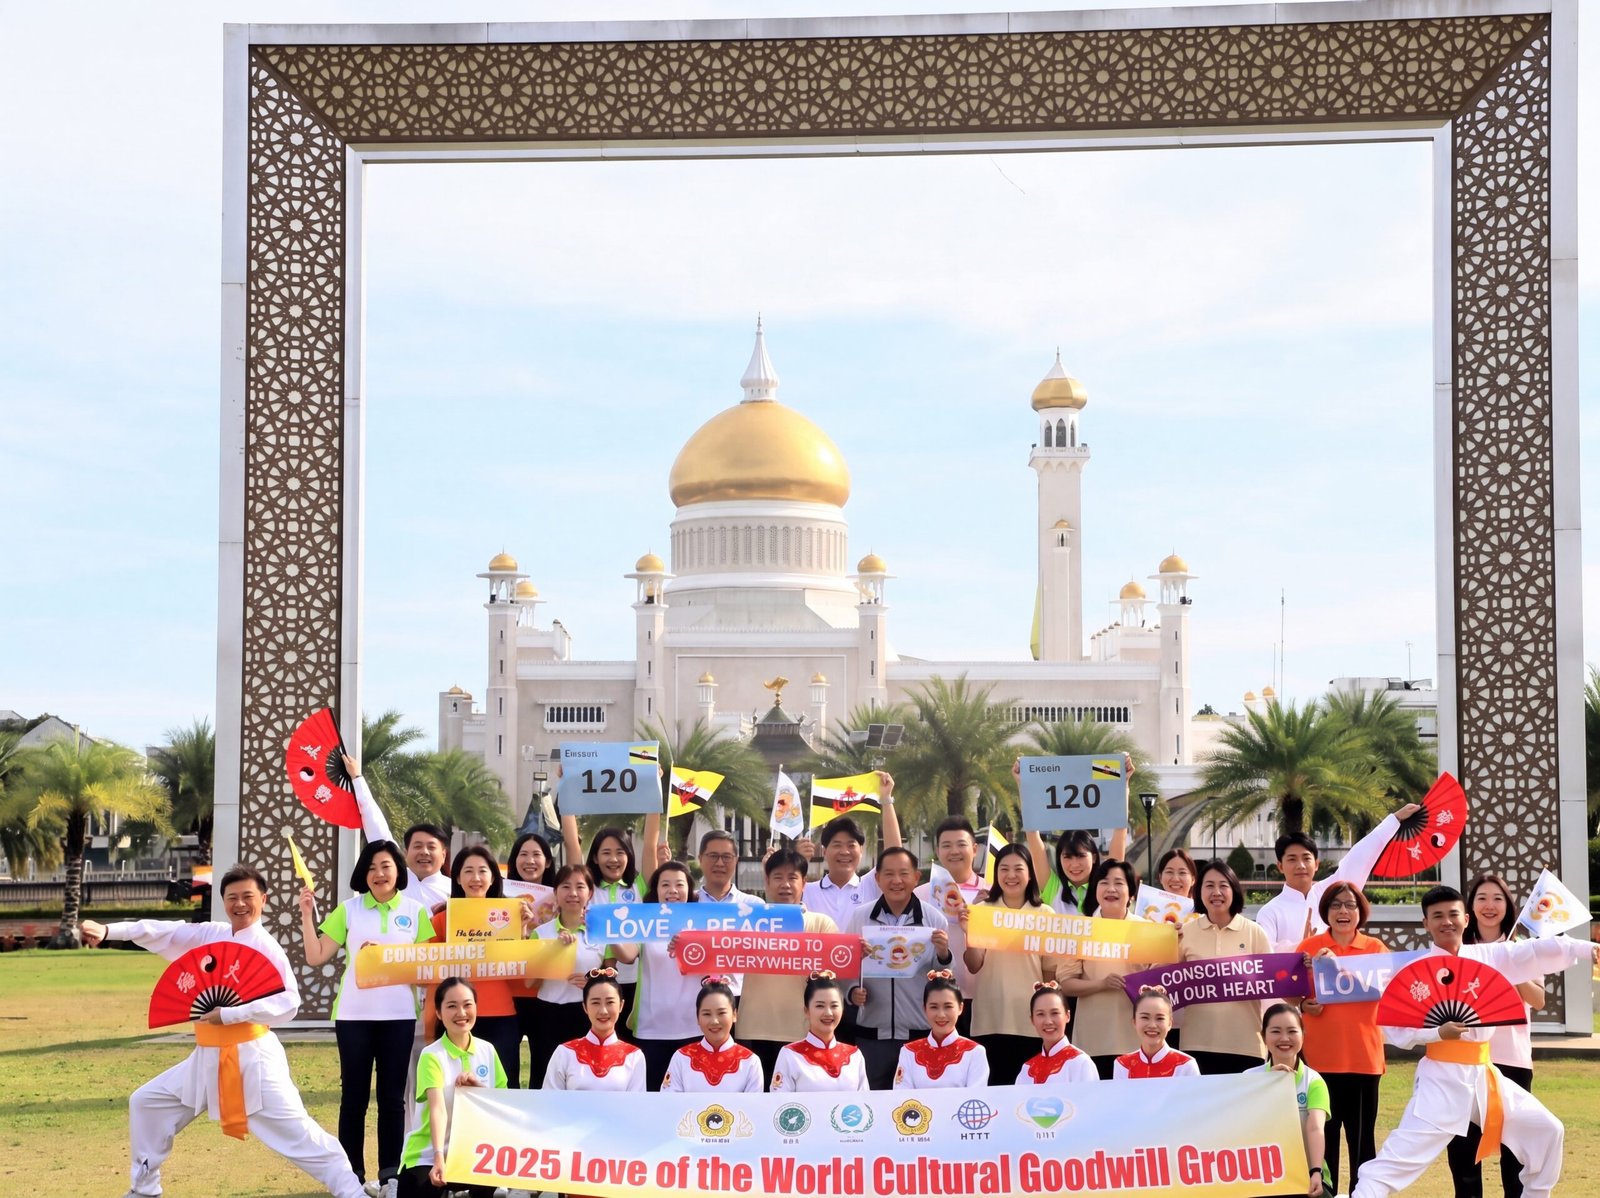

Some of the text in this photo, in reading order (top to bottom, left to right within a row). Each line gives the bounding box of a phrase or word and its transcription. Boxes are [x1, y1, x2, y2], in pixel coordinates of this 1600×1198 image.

[581, 768, 637, 793] 120
[1045, 783, 1101, 809] 120
[606, 919, 670, 938] LOVE
[992, 910, 1093, 936] CONSCIENCE
[383, 944, 486, 964] CONSCIENCE
[711, 936, 823, 952] LOPSINERD TO
[1023, 935, 1131, 960] IN OUR HEART
[416, 961, 528, 980] IN OUR HEART
[715, 955, 823, 971] EVERYWHERE
[1161, 959, 1264, 987] CONSCIENCE
[1183, 984, 1218, 1001] OUR
[1223, 979, 1275, 997] HEART
[1318, 968, 1392, 996] LOVE
[960, 1132, 990, 1141] HTTT
[473, 1143, 1283, 1196] 2025 Love of the World Cultural Goodwill Group
